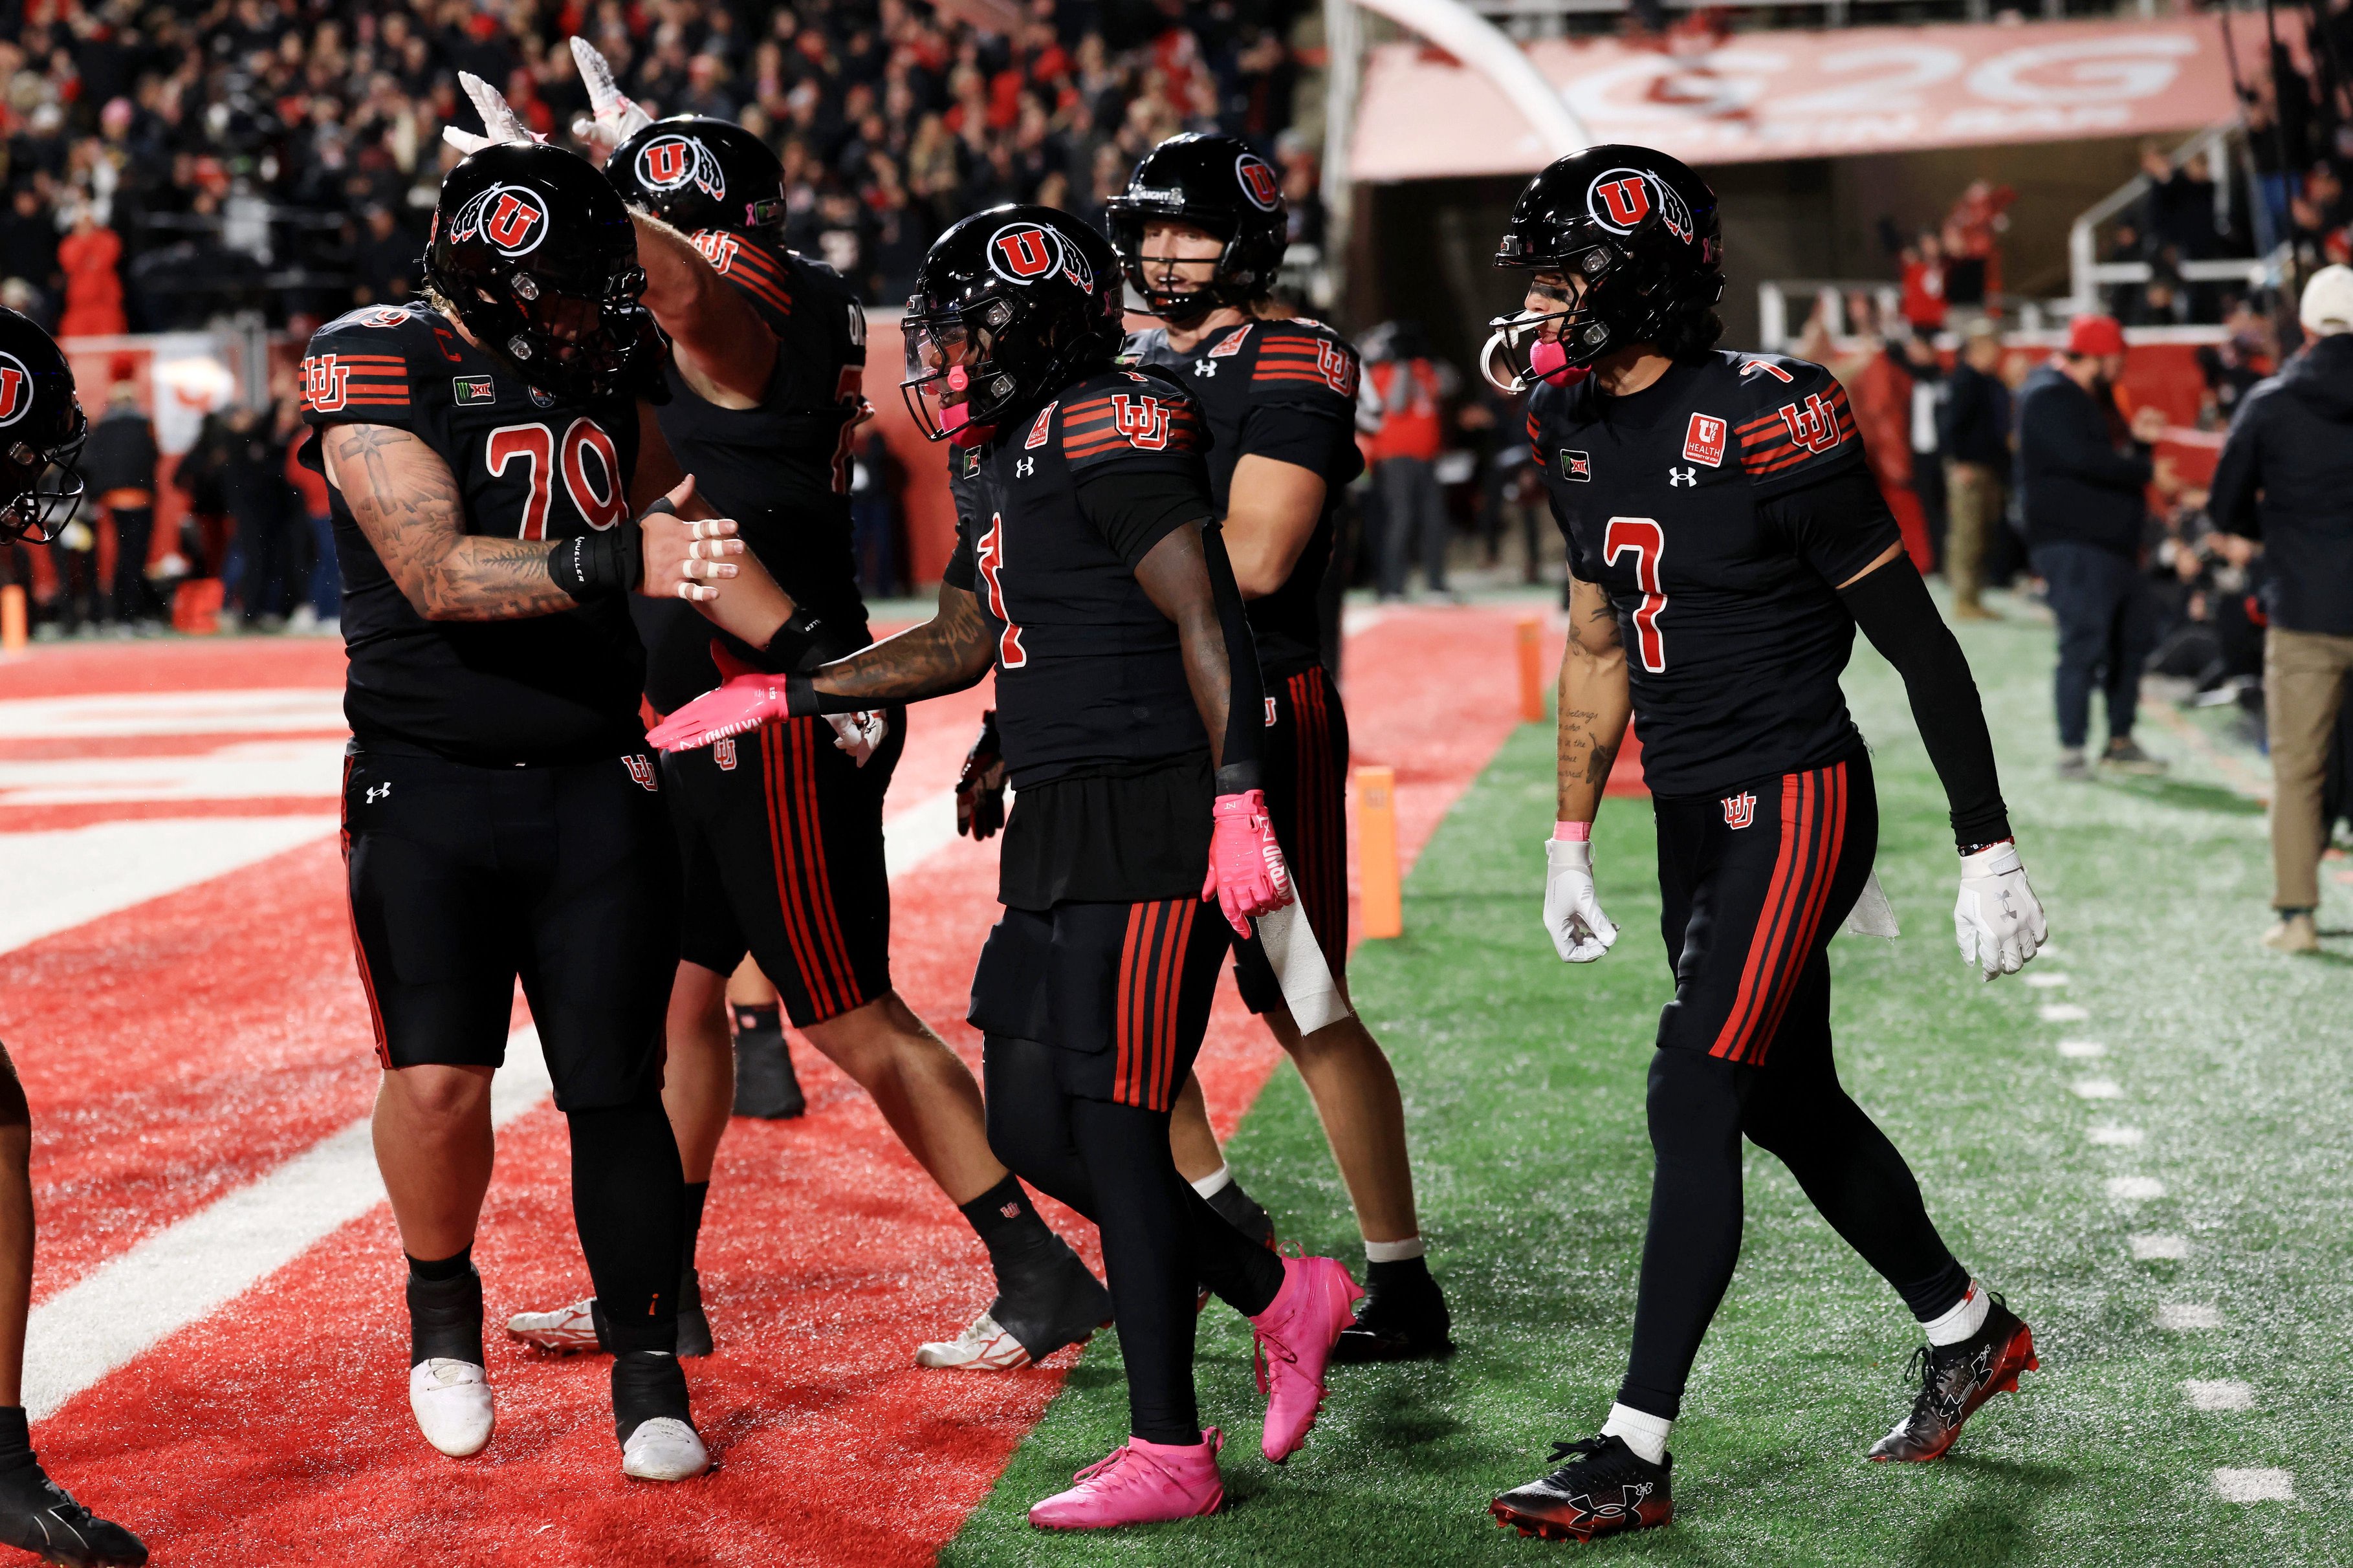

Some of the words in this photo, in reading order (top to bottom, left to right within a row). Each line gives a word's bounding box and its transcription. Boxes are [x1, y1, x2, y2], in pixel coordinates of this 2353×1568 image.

[644, 142, 687, 184] U
[1240, 163, 1277, 205] U
[487, 192, 542, 249] U
[1595, 176, 1651, 227] U
[996, 229, 1051, 278] U
[433, 327, 462, 362] C
[1688, 441, 1720, 457] HEALTH
[573, 536, 585, 582] MUELLER
[976, 512, 1027, 669] 1
[1603, 516, 1669, 673] 7
